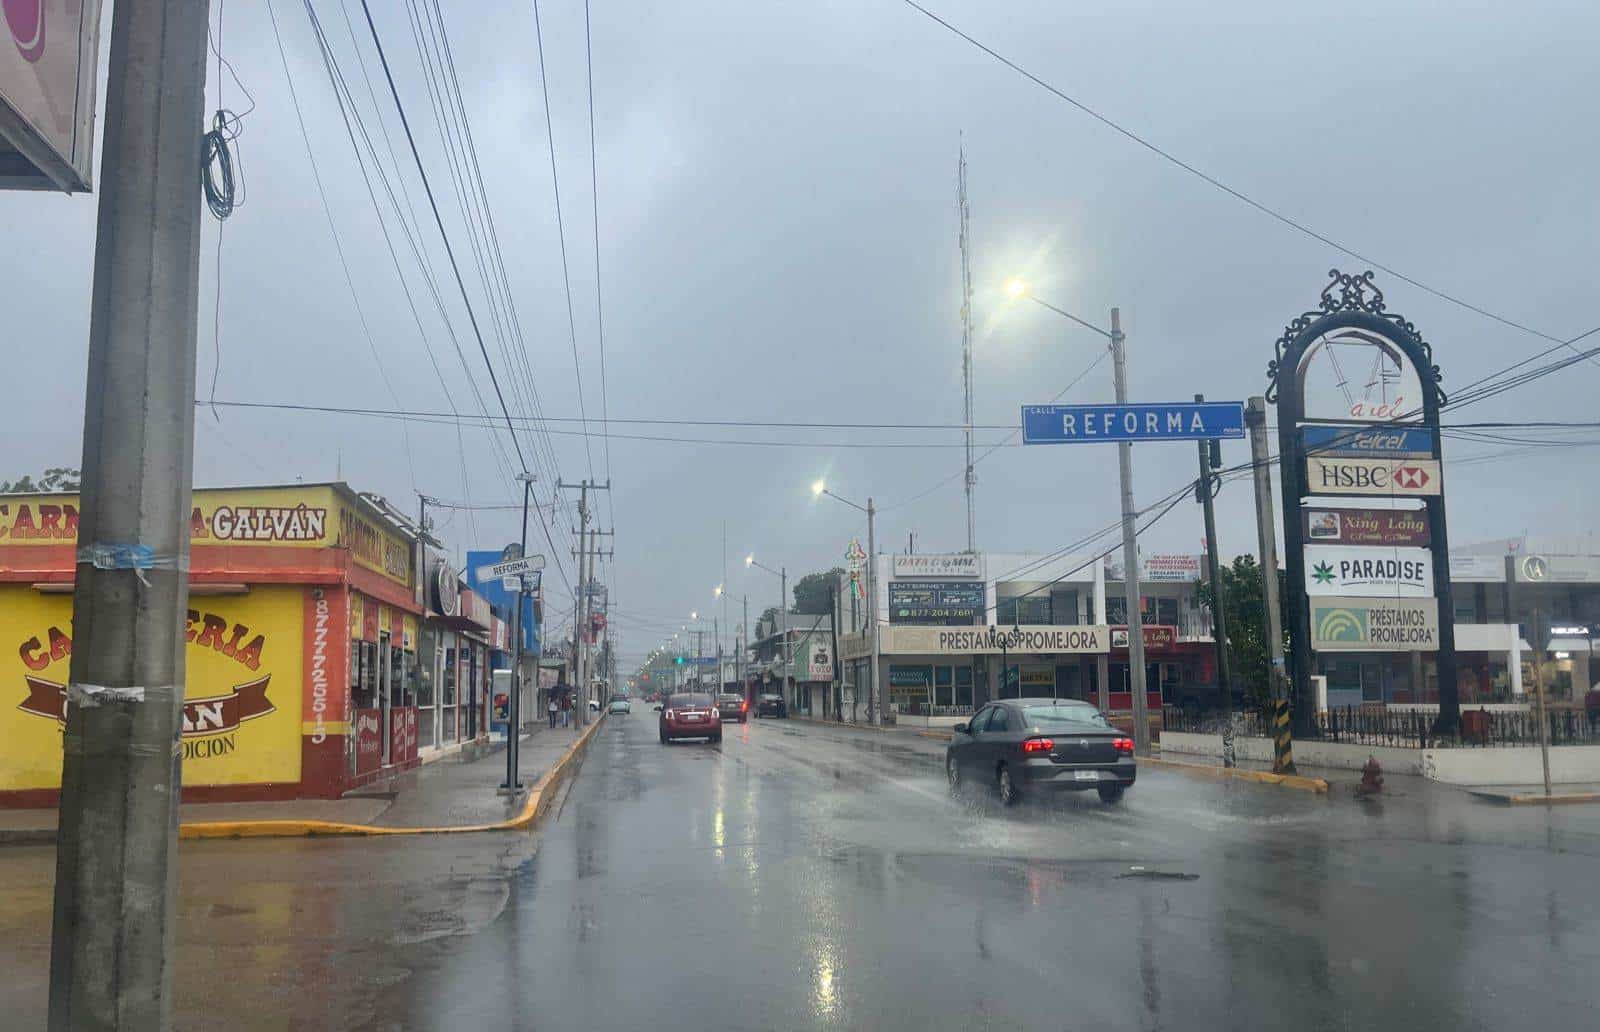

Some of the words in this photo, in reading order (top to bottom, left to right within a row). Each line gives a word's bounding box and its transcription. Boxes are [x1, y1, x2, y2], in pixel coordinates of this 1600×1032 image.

[1062, 412, 1206, 435] REFORMA
[1321, 465, 1388, 488] HSBC
[212, 503, 327, 541] GALVÁN
[1388, 517, 1425, 532] Long
[492, 560, 529, 576] REFORMA
[1340, 559, 1425, 581] PARADISE
[18, 609, 266, 671] CAERIA
[1017, 630, 1099, 649] PROMEJORA
[1370, 628, 1433, 643] PROMEJORA
